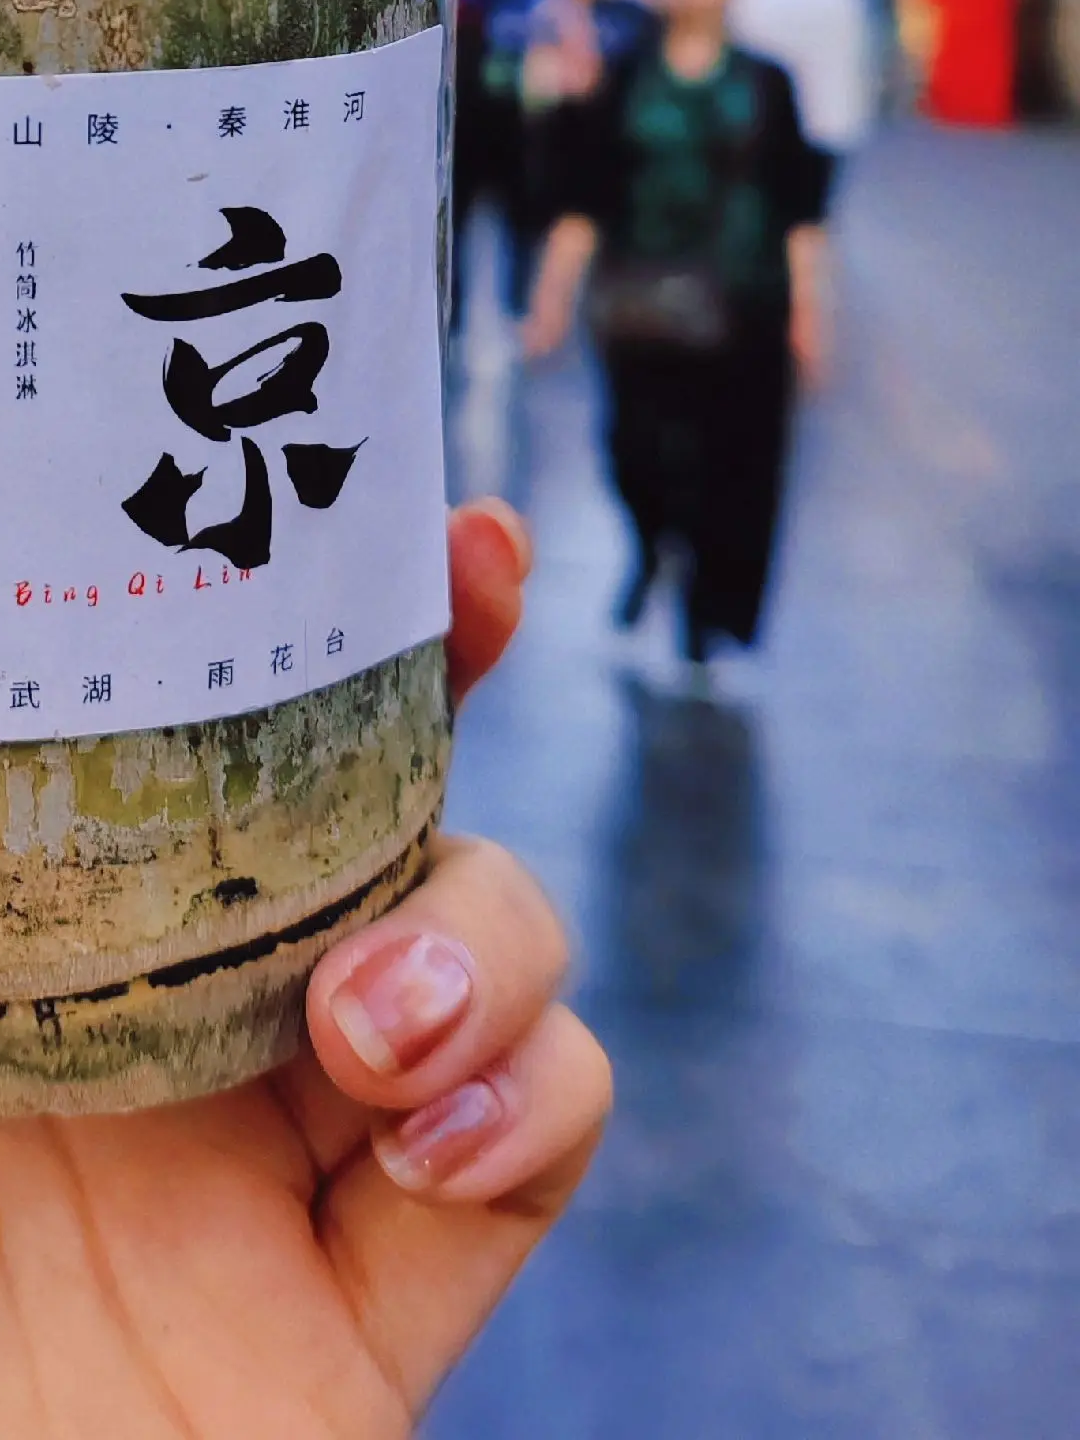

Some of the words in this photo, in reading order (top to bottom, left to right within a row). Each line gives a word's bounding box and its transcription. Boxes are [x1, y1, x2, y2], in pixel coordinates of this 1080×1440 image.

[15, 239, 39, 401] 竹筒冰淇淋
[14, 579, 100, 607] Bing
[127, 570, 165, 598] Qi
[193, 564, 252, 591] Lin
